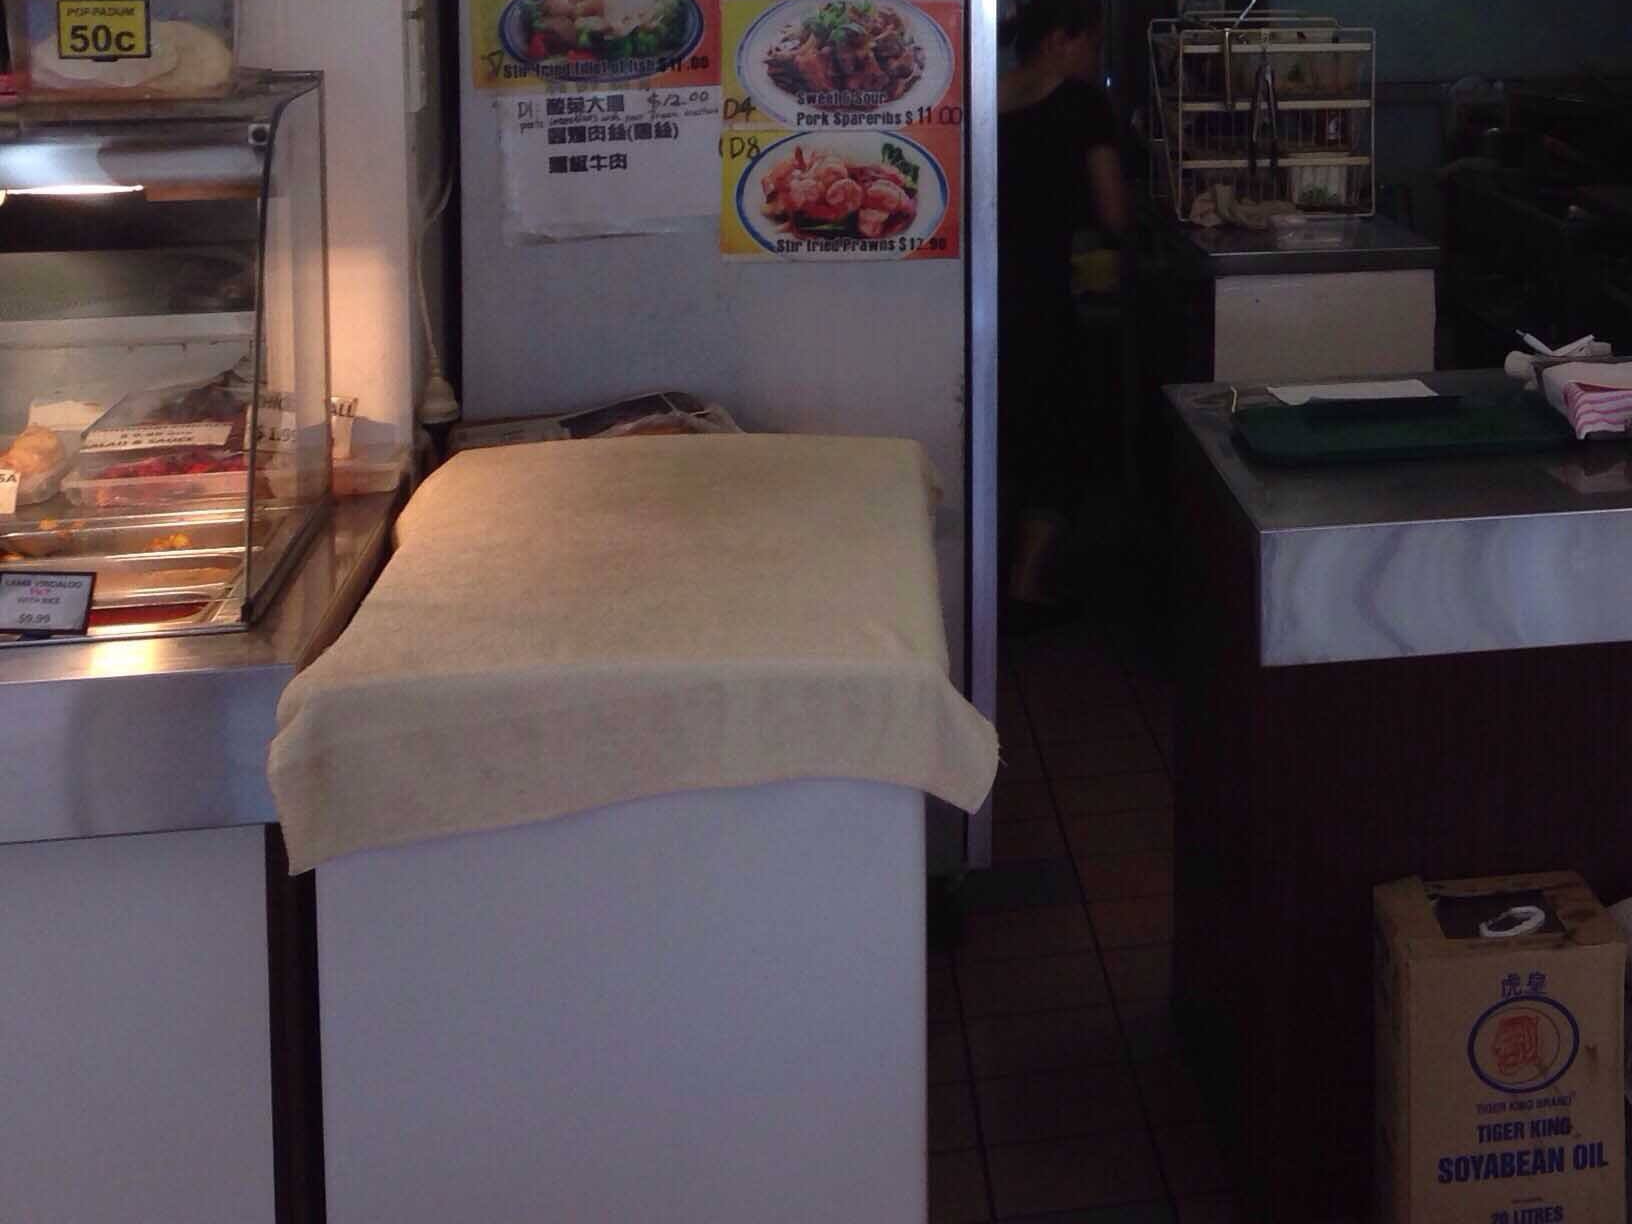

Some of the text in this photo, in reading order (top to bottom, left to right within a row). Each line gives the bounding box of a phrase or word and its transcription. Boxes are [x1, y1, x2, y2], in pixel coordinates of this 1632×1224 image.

[70, 25, 136, 52] 50c
[1477, 1117, 1572, 1143] TIGER KING
[1438, 1141, 1608, 1184] SOYABEAN OIL
[1512, 1206, 1564, 1224] LITRES
